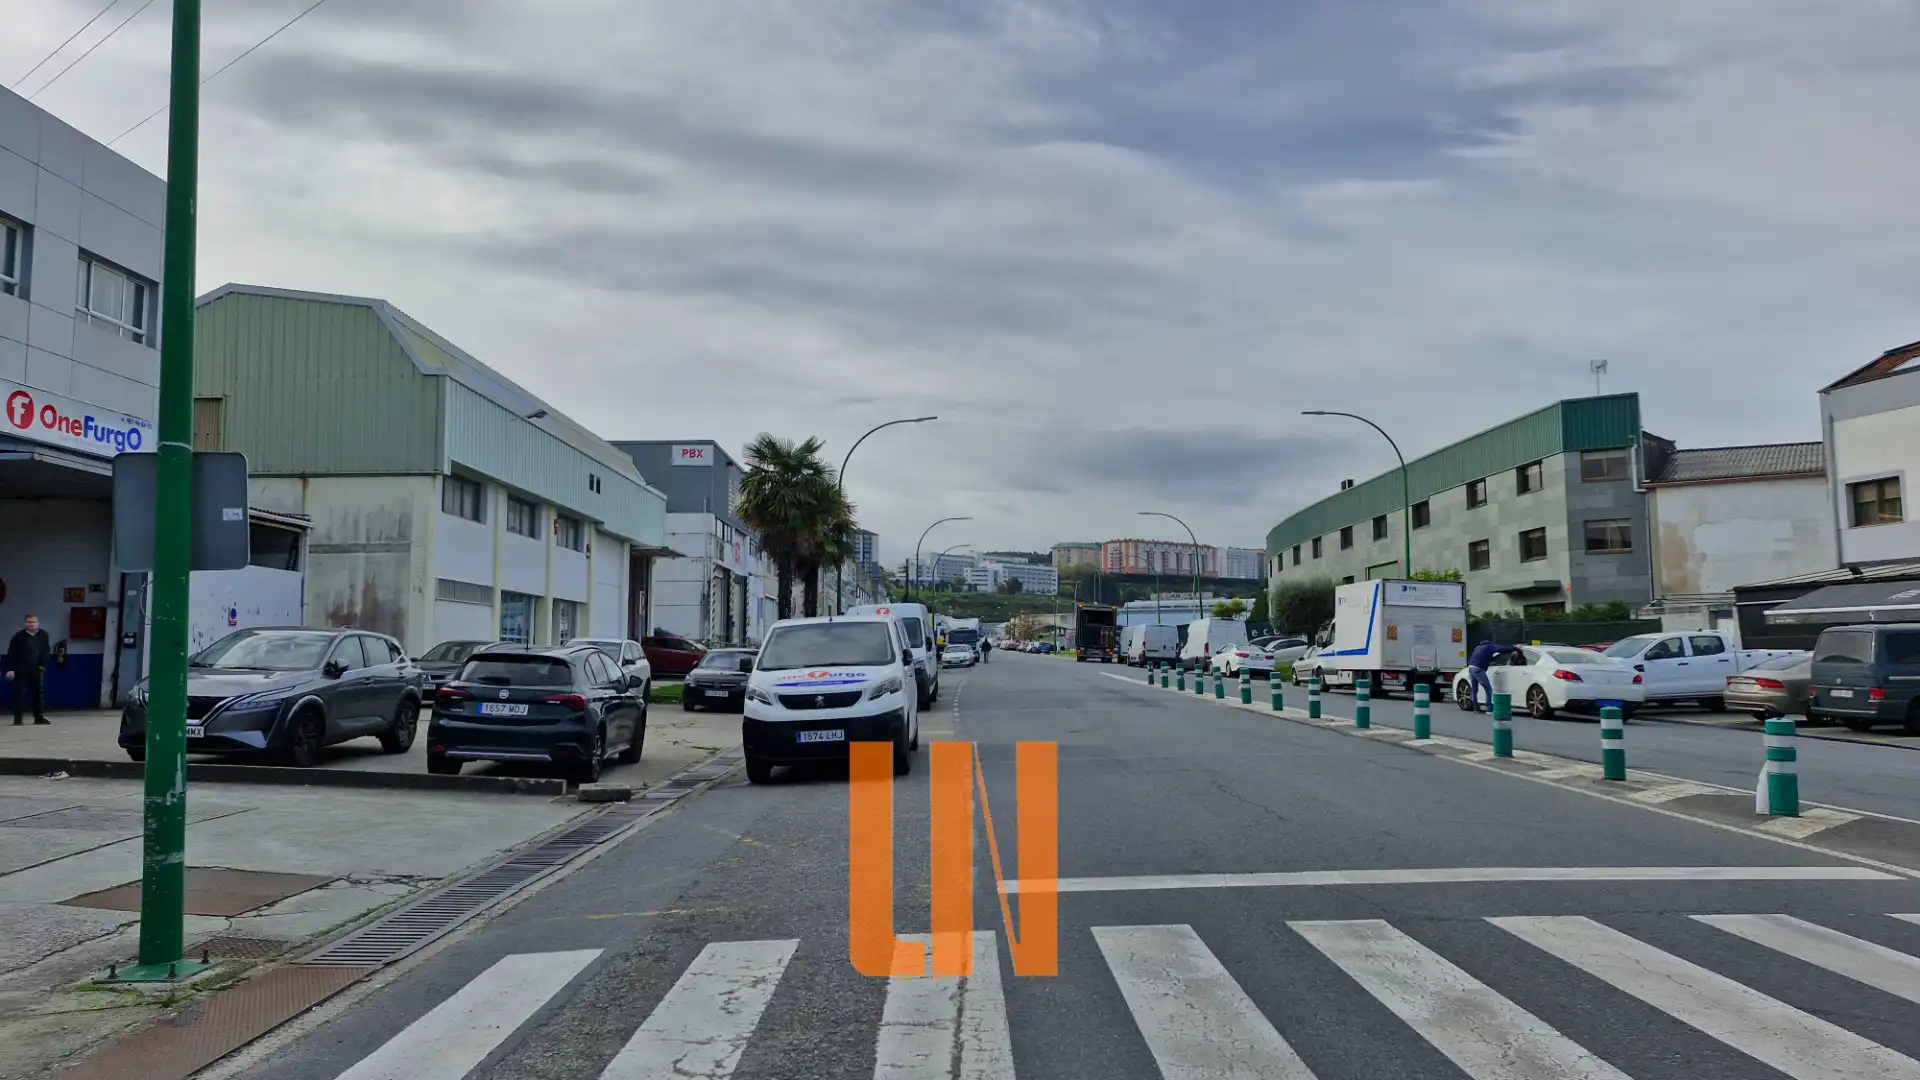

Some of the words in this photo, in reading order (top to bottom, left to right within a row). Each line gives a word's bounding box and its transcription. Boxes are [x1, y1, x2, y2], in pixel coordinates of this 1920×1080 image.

[682, 448, 703, 459] PBX
[484, 703, 507, 713] 1657
[508, 704, 527, 714] MDJ
[803, 731, 824, 741] 1574
[825, 730, 843, 740] LHJ
